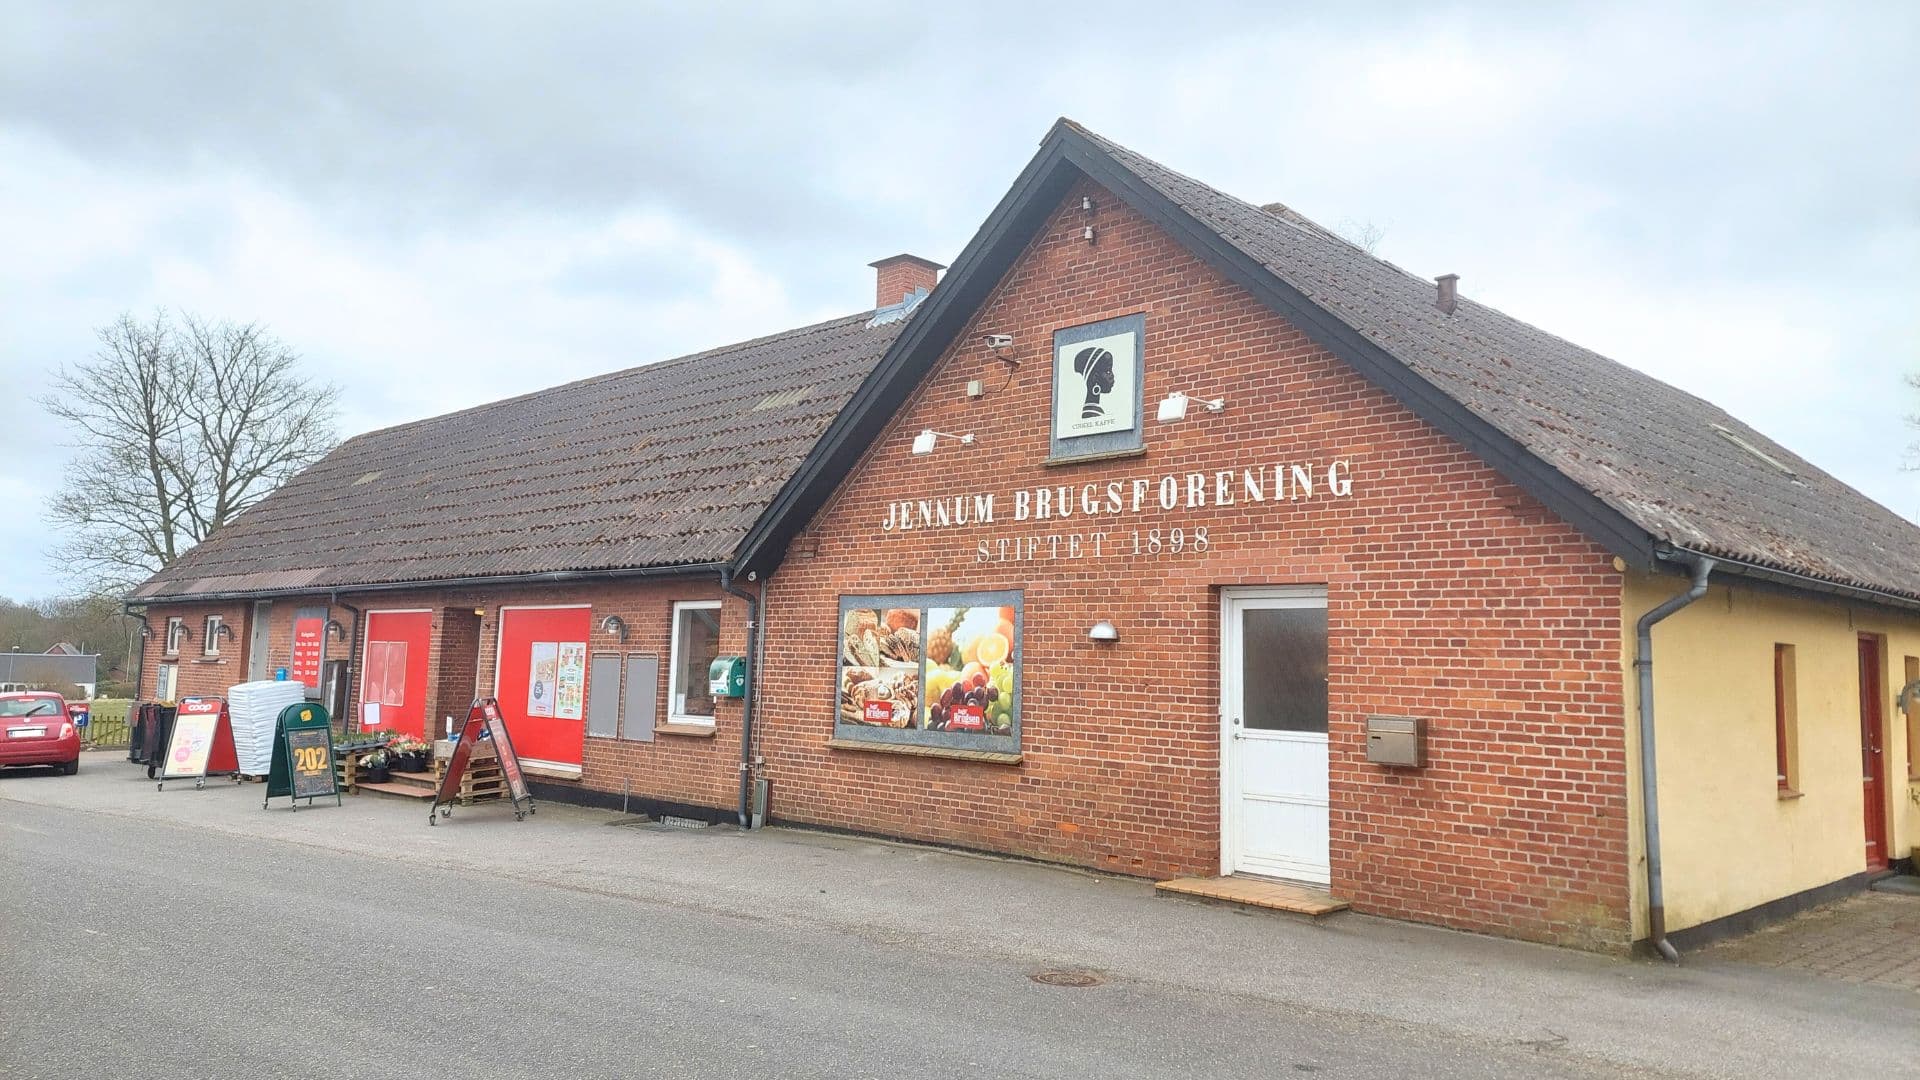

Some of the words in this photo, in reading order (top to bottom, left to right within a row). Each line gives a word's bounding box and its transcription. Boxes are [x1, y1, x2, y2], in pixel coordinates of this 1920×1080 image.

[882, 494, 995, 531] JENNUM
[1014, 459, 1354, 521] BRUGSFORENING
[977, 531, 1106, 563] STIFTET
[1131, 526, 1210, 556] 1898
[294, 747, 328, 771] 202
